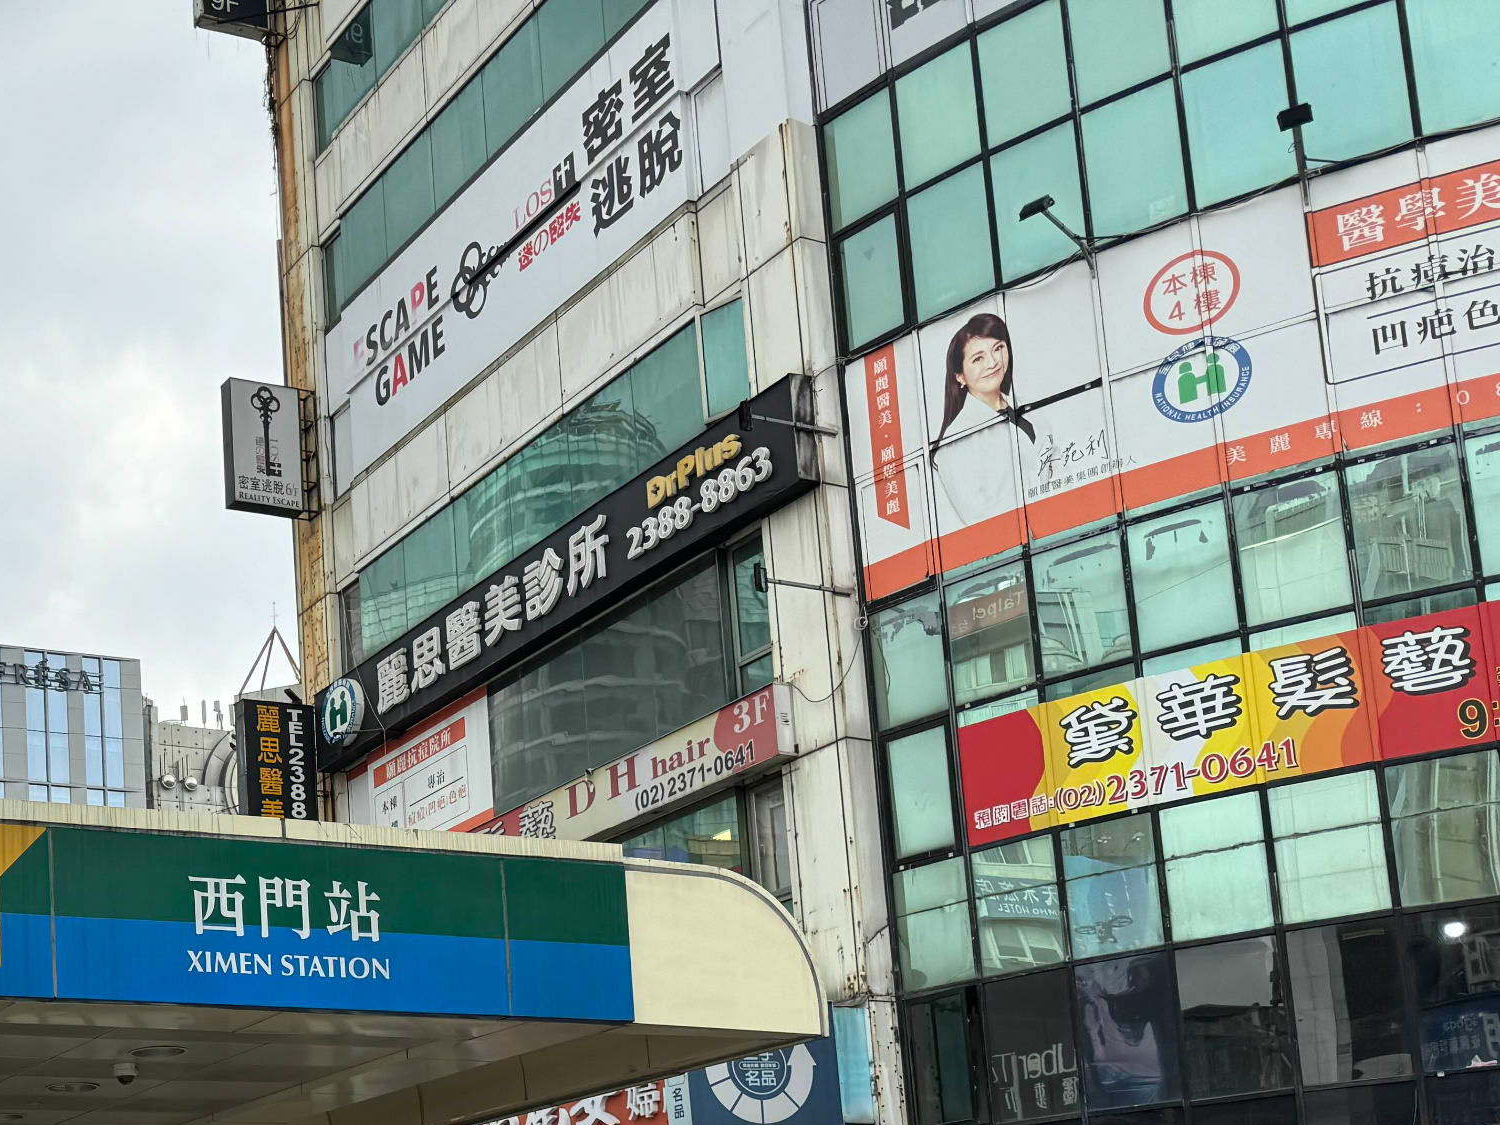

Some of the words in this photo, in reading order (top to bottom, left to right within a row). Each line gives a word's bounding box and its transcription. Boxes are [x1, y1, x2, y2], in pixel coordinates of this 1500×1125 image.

[582, 32, 675, 166] 密室
[590, 111, 682, 239] 逃脫
[1162, 262, 1217, 296] 本棟
[1168, 289, 1222, 321] 4樓
[350, 265, 440, 369] ESCAPE
[374, 315, 446, 406] GAME
[1154, 392, 1182, 421] NATIONAL
[1185, 406, 1219, 421] HEALTH
[1220, 365, 1250, 412] INSURANCE
[239, 492, 271, 503] REALITY
[273, 496, 300, 508] ESCAPE
[626, 446, 774, 560] 2388-8863
[647, 433, 742, 509] DrPlus
[377, 515, 610, 716] 麗思醫美診所
[733, 690, 771, 734] 3F
[256, 704, 285, 818] 麗思醫美
[564, 779, 596, 820] D
[606, 754, 641, 800] H
[650, 736, 710, 780] hair
[634, 740, 756, 812] (02)2371-0641
[1054, 736, 1300, 815] (02)2371-0641
[187, 874, 381, 943] 西門站
[187, 950, 272, 976] XIMEN
[281, 954, 390, 980] STATION
[672, 1087, 685, 1119] 名品
[745, 1070, 777, 1087] 名品
